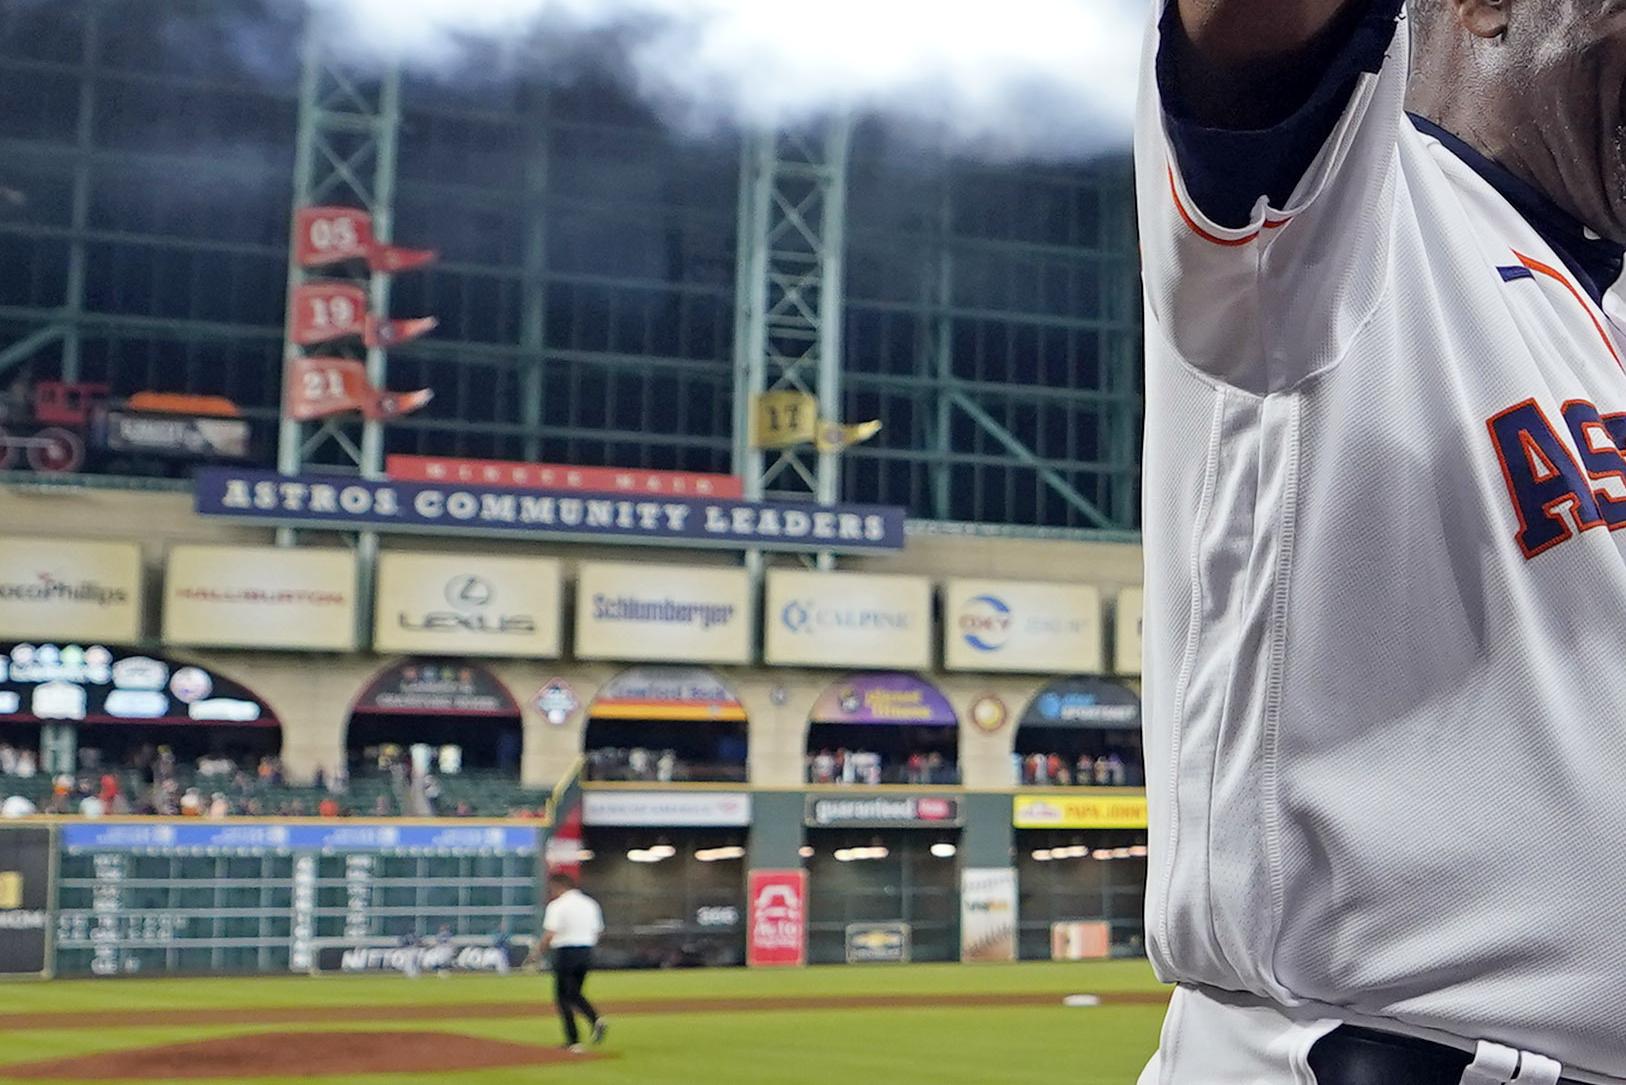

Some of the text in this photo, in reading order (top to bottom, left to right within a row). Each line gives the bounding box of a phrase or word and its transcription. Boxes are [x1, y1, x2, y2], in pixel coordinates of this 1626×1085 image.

[310, 217, 357, 252] 05
[311, 295, 355, 328] 19
[303, 368, 344, 400] 21
[222, 479, 886, 541] ASTROS COMMUNITY LEADERS
[398, 612, 536, 635] LEXUS
[592, 593, 734, 628] Schlumberger
